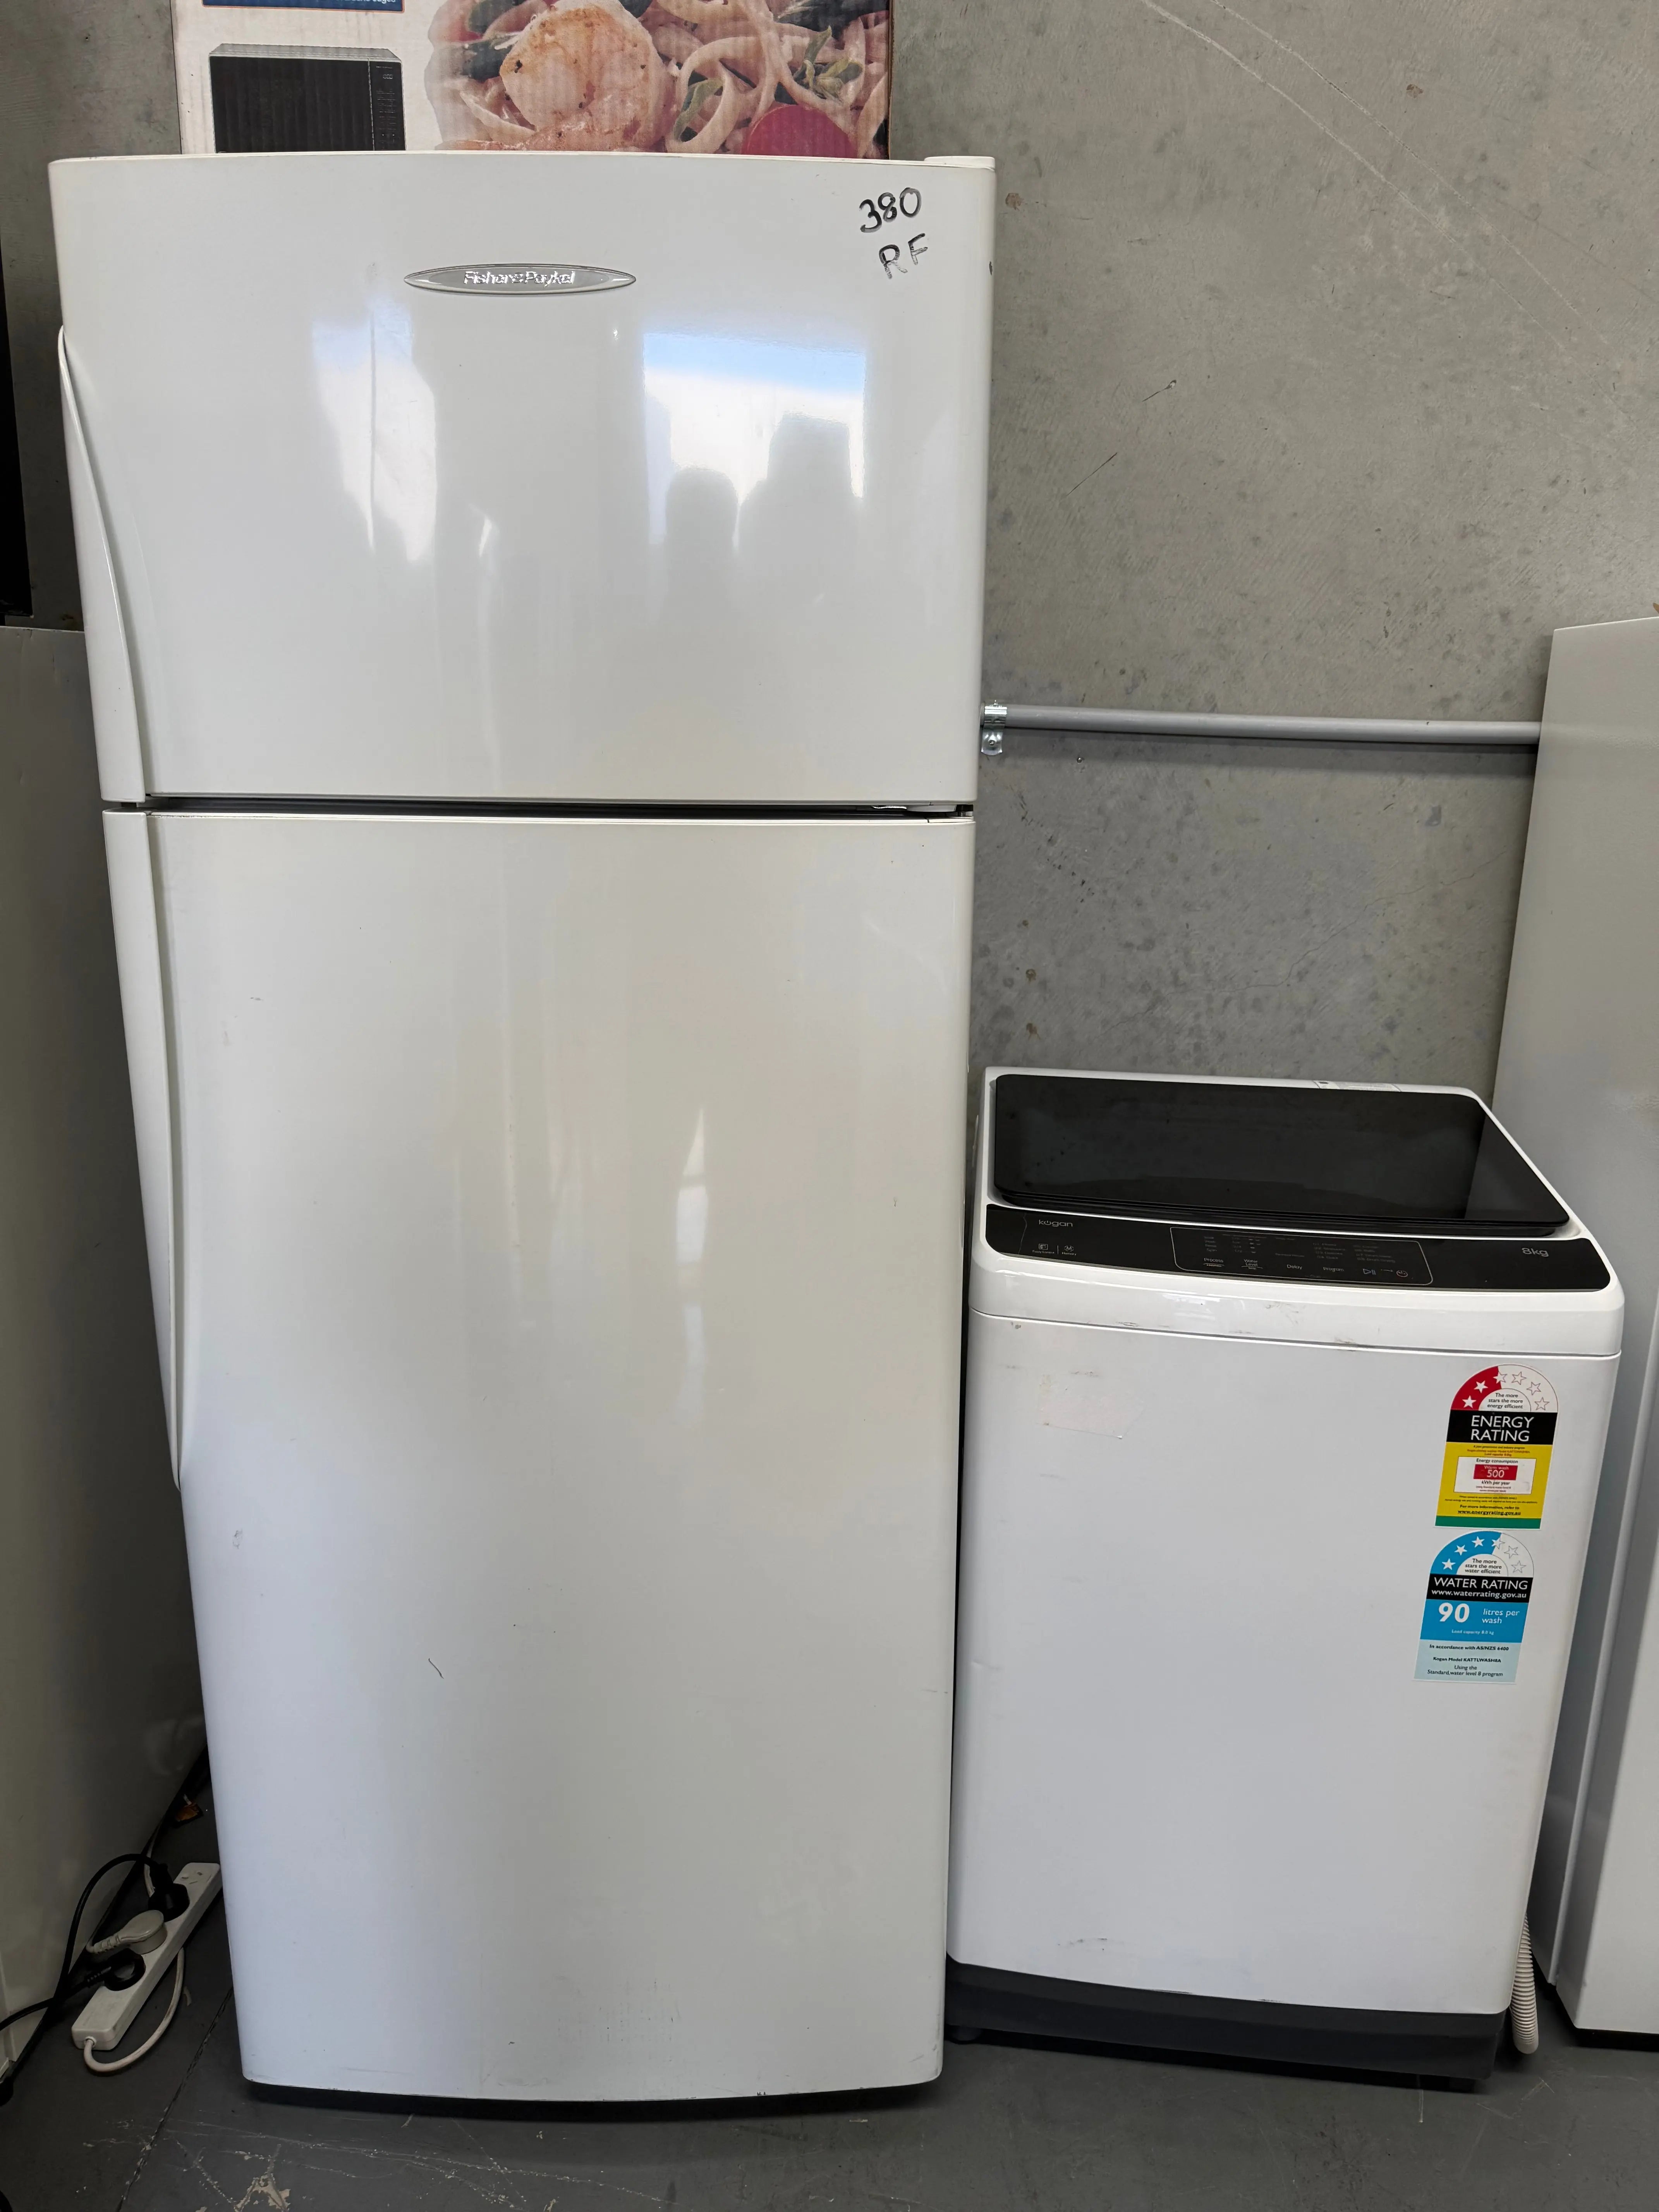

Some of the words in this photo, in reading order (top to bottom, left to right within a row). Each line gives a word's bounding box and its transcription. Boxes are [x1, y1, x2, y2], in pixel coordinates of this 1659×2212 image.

[859, 187, 922, 233] 380
[879, 233, 928, 279] RF
[1522, 1247, 1549, 1257] 8kg
[1471, 1415, 1534, 1428] ENERGY
[1471, 1429, 1530, 1442] RATING
[1486, 1469, 1504, 1478] 500
[1434, 1577, 1477, 1589] WATER
[1481, 1579, 1528, 1590] RATING
[1431, 1589, 1527, 1599] www.waterrating.gov.au
[1439, 1602, 1470, 1623] 90
